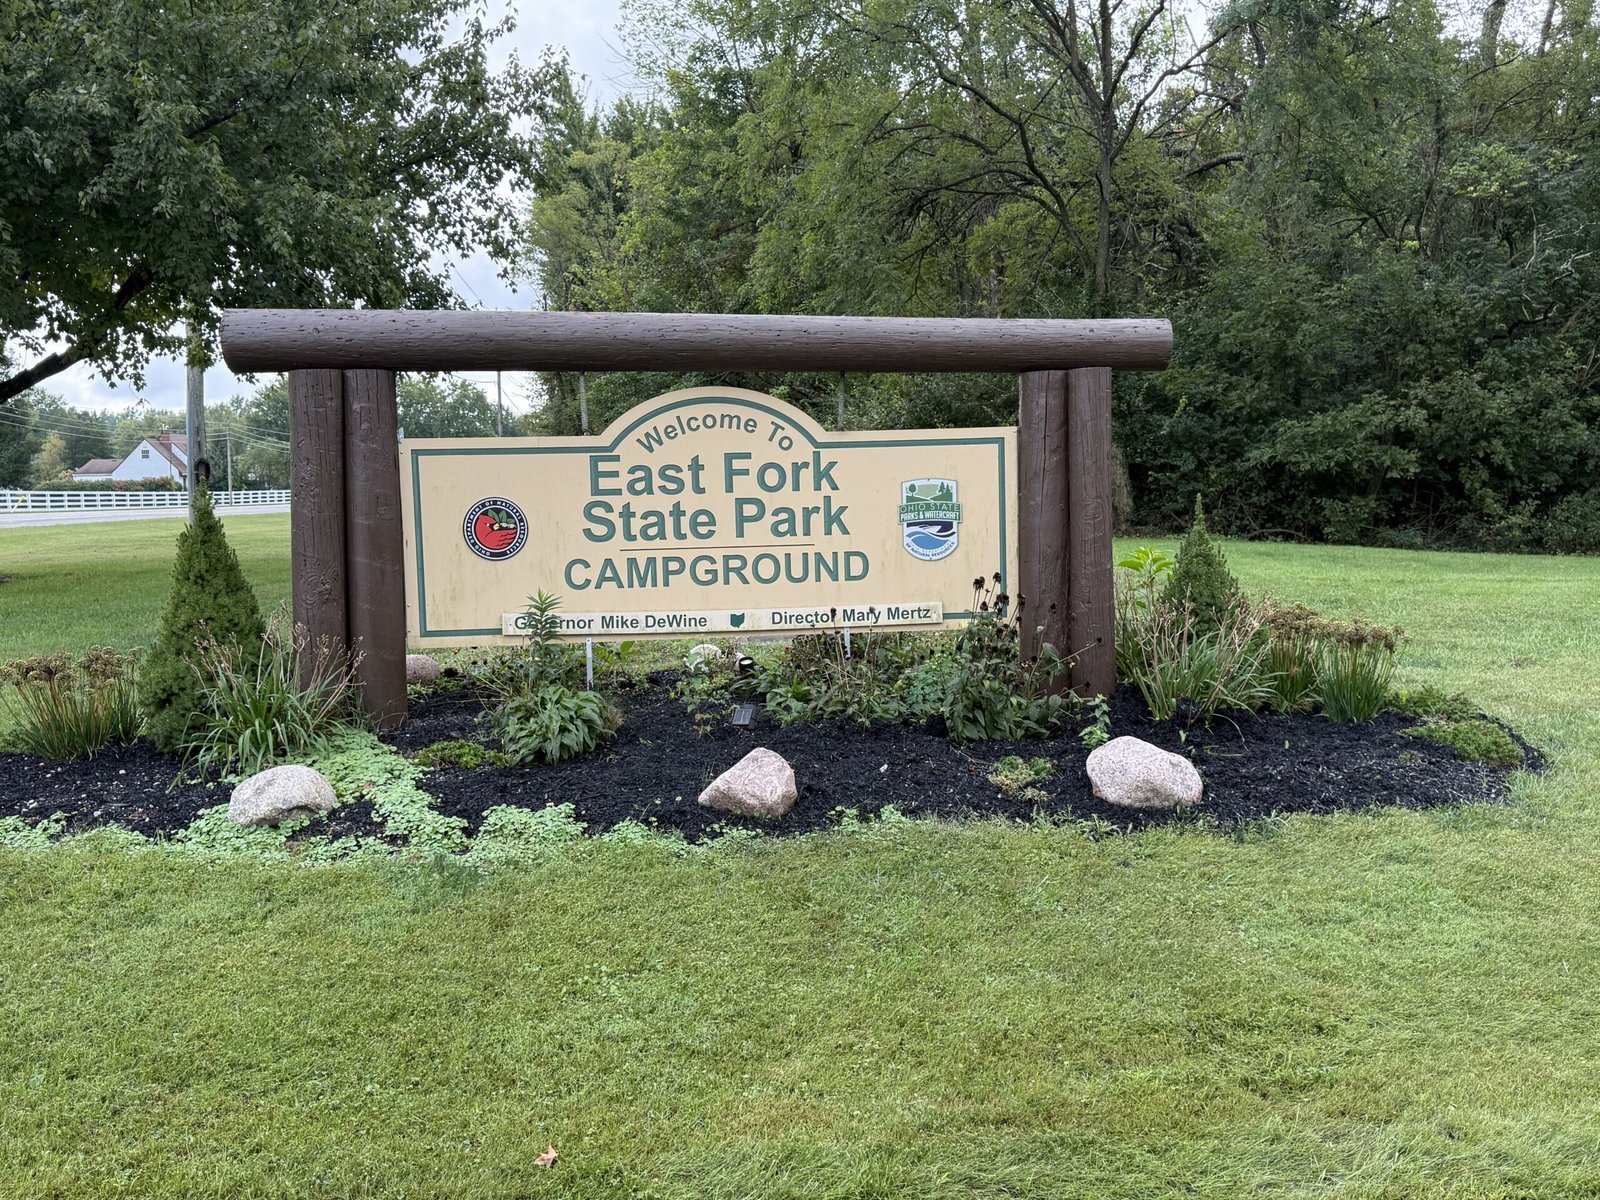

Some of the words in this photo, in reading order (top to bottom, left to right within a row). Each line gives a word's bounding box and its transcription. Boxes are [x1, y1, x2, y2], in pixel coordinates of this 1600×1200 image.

[636, 413, 758, 453] Welcome
[768, 421, 793, 451] To
[589, 454, 706, 496] East
[724, 450, 840, 494] Fork
[582, 500, 717, 542] State
[734, 496, 850, 538] Park
[900, 504, 925, 513] OHIO
[930, 502, 959, 511] STATE
[900, 511, 918, 521] PARKS
[919, 511, 924, 519] &
[924, 510, 959, 520] WATERCRAFT
[564, 551, 870, 590] CAMPGROUND
[601, 615, 639, 629] Mike
[645, 614, 707, 628] DeWine
[887, 606, 931, 620] Mertz
